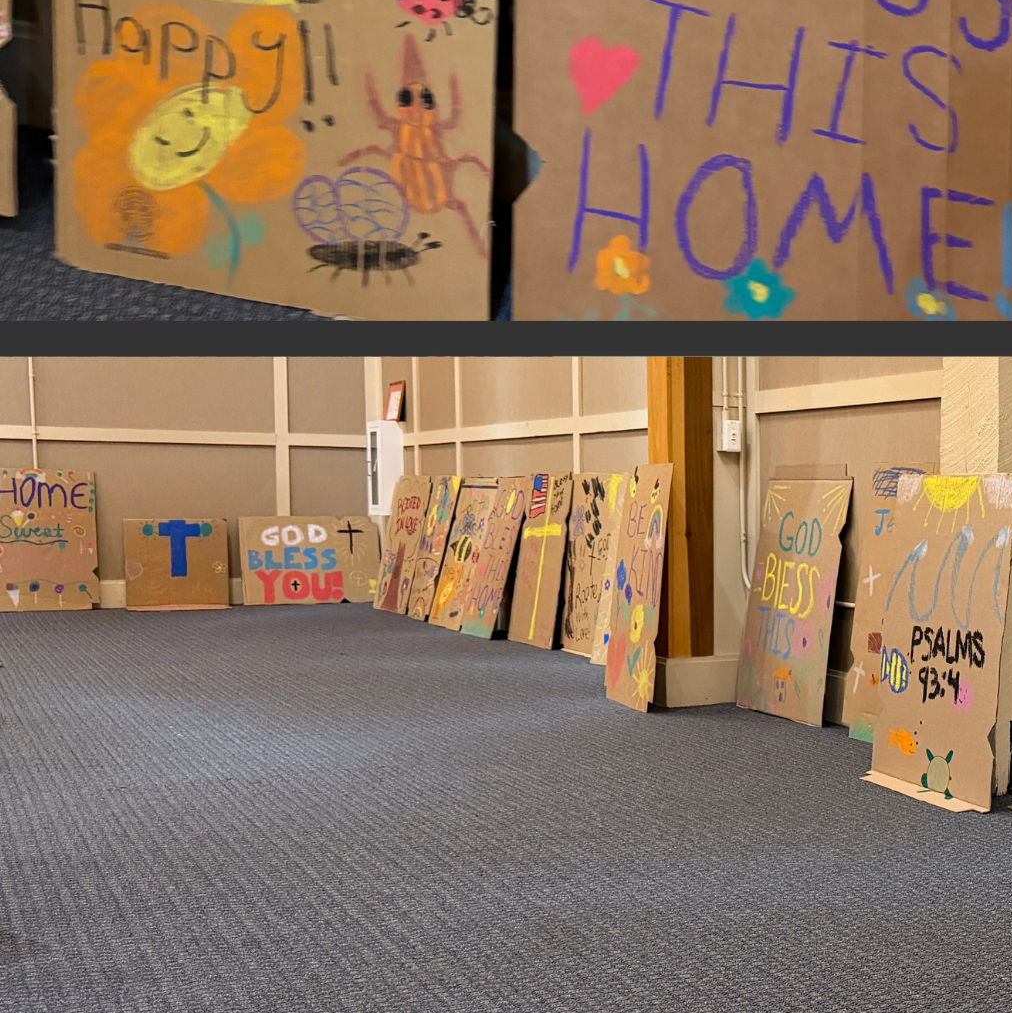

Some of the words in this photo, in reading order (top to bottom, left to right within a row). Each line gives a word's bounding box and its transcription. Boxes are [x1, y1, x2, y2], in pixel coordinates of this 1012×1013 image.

[397, 496, 421, 515] ROOTED
[495, 489, 525, 521] GOD
[627, 501, 648, 538] BE
[0, 514, 65, 539] Sweet
[260, 524, 328, 547] GOD
[395, 517, 404, 535] IN
[404, 516, 419, 532] LOVE
[779, 511, 822, 558] GOD
[248, 546, 338, 571] BLESS
[254, 569, 344, 604] YOU!
[628, 544, 663, 610] KIND
[757, 606, 795, 661] THIS
[910, 625, 986, 669] PSALMS
[918, 666, 962, 705] 93:4
